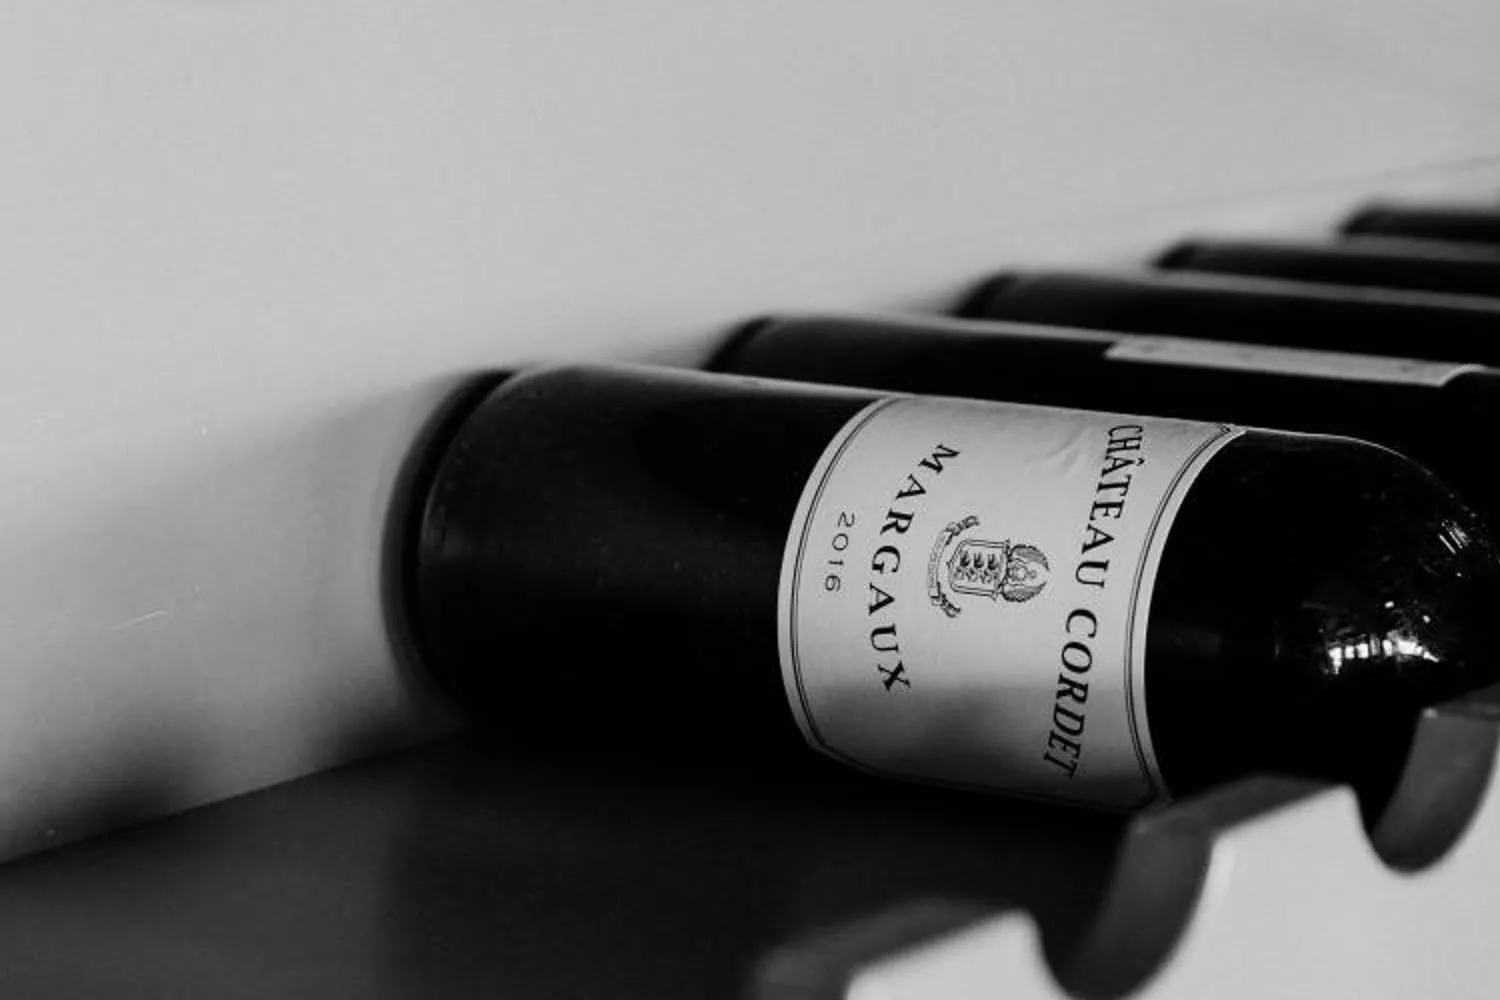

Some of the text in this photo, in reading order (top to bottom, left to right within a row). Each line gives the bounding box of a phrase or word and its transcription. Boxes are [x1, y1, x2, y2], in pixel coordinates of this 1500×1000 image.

[823, 511, 856, 594] 2016
[867, 444, 961, 692] MARGAUX
[1043, 424, 1146, 779] CHÂTEAU CORDET
